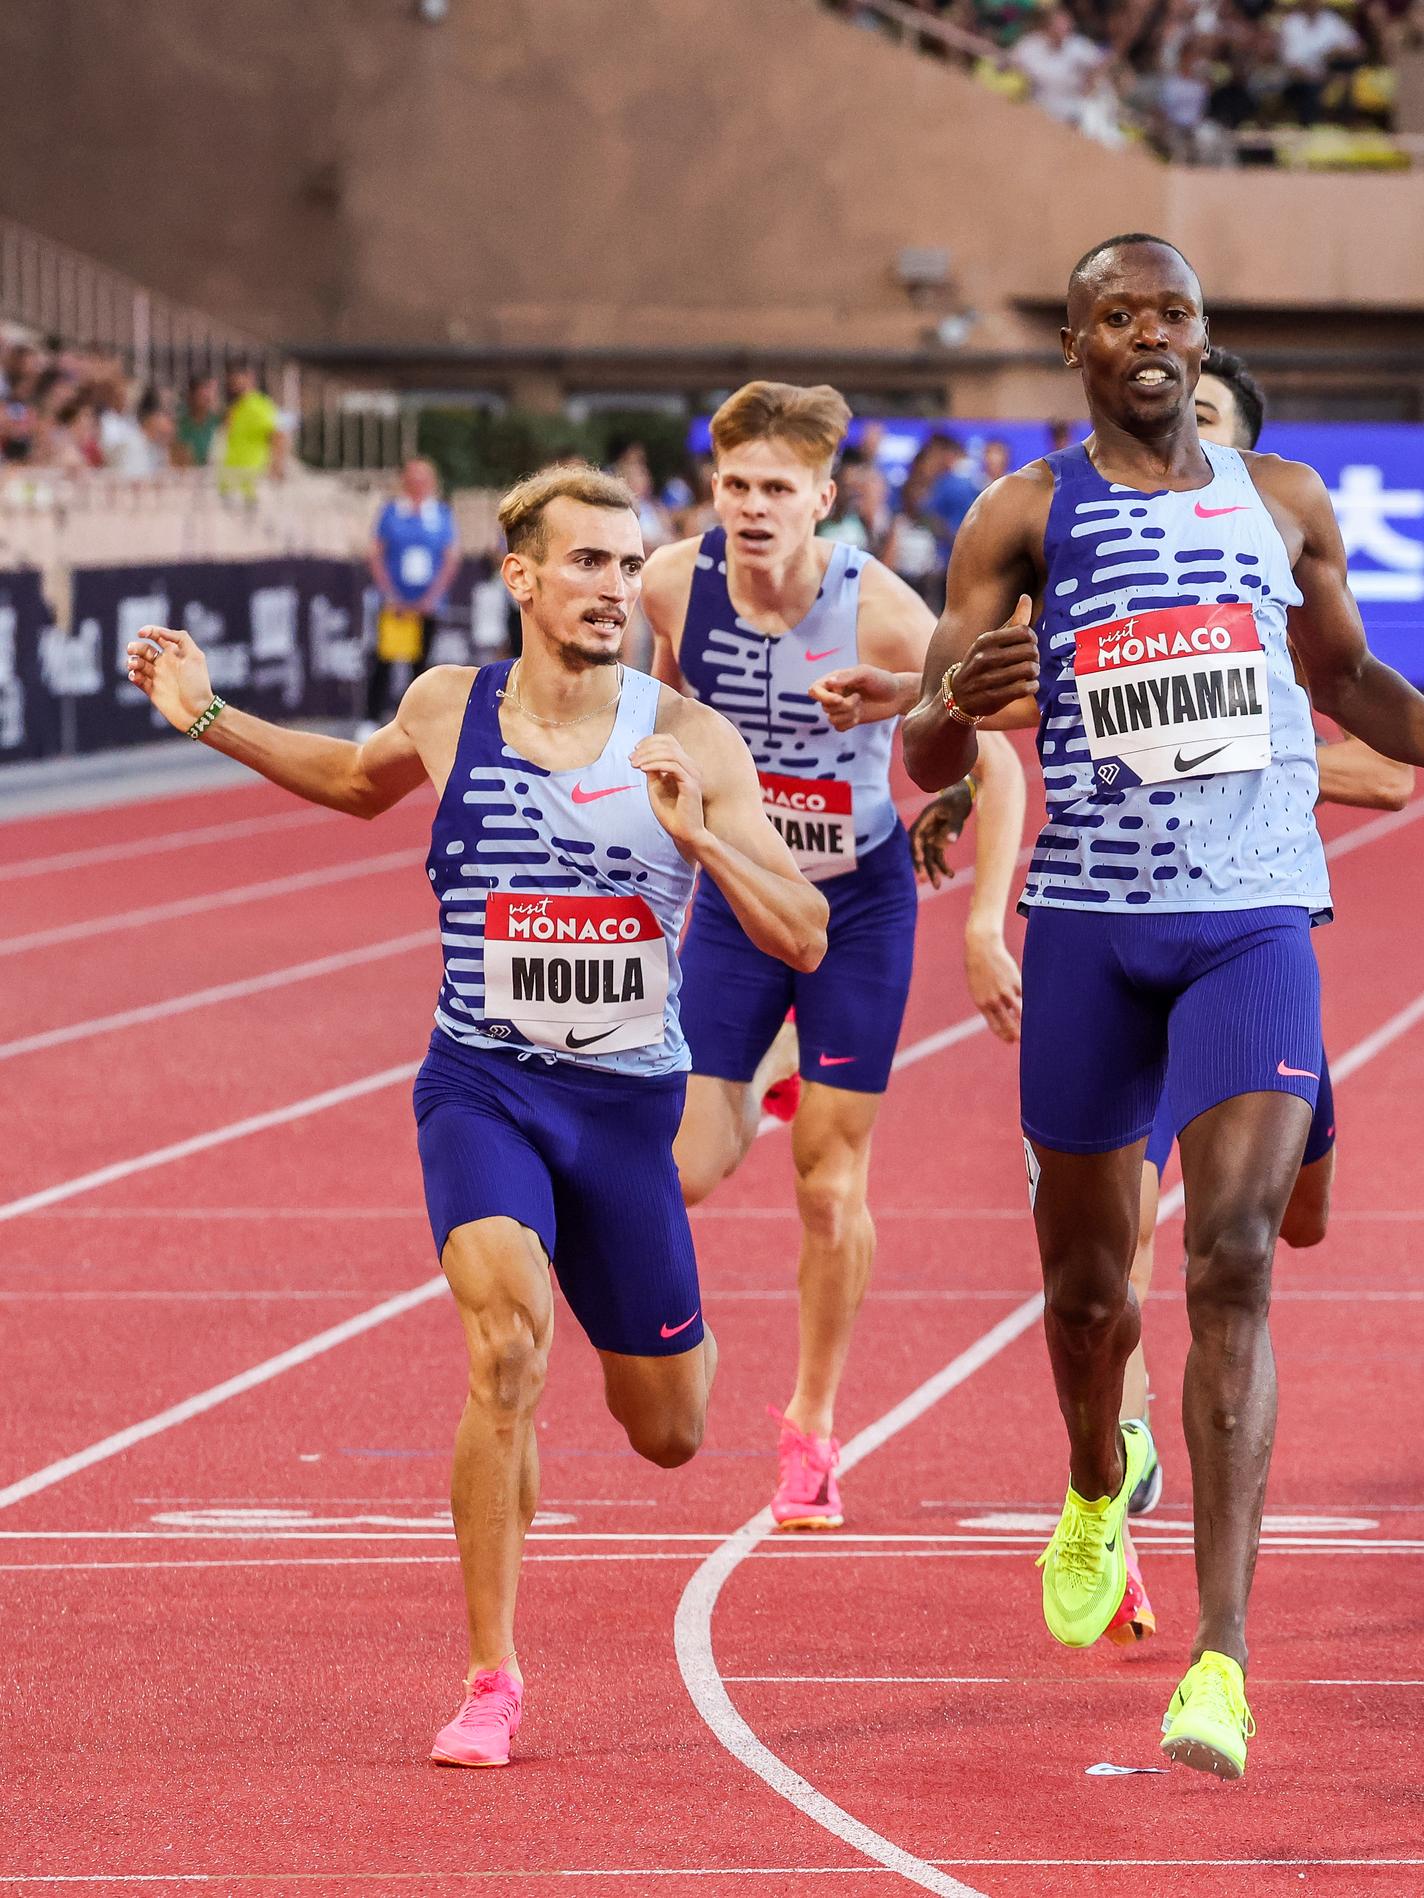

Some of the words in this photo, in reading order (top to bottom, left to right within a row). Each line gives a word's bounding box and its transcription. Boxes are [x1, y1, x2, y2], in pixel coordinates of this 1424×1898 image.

[1098, 618, 1139, 647] visit
[1098, 626, 1231, 668] MONACO
[1088, 667, 1263, 738] KINYAMAL
[760, 785, 826, 811] NACO
[508, 897, 553, 916] visit
[508, 915, 641, 941] MONACO
[511, 957, 644, 1004] MOULA
